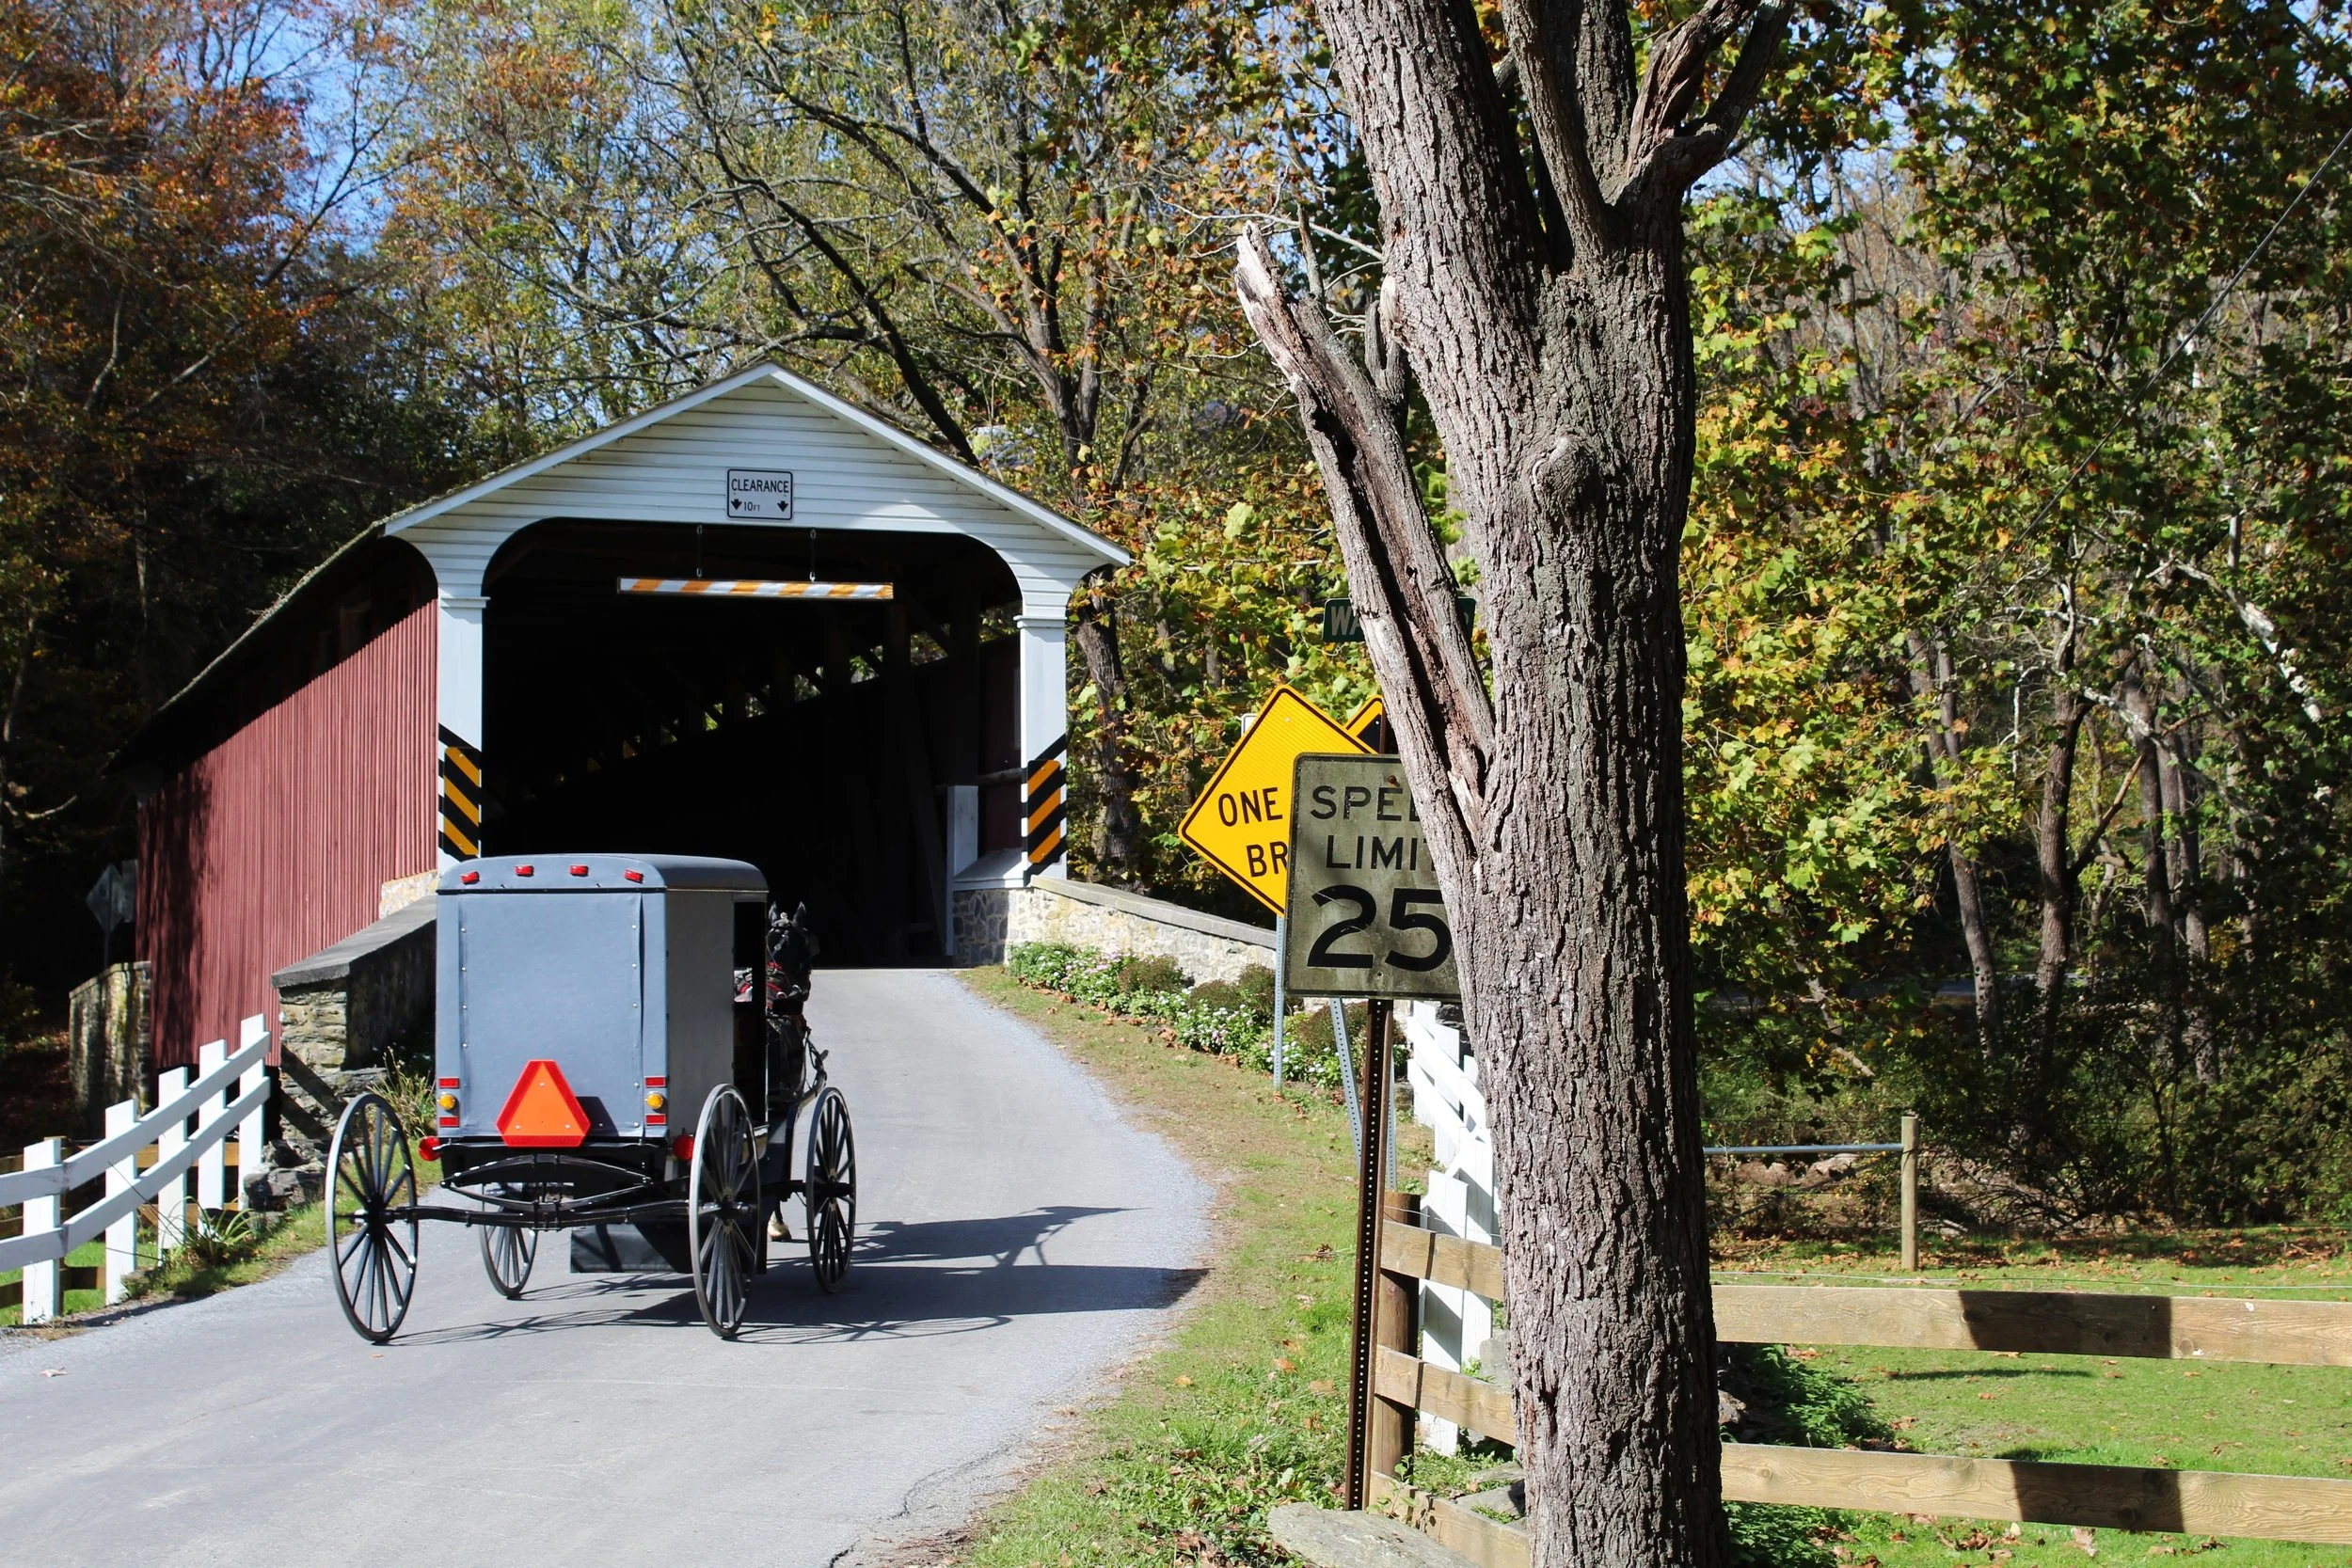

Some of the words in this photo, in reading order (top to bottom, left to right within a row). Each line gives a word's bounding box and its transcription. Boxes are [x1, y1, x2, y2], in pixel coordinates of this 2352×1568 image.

[731, 478, 789, 493] CLEARANCE
[1218, 787, 1283, 827] ONE
[1326, 834, 1436, 871] LIMI
[1307, 884, 1454, 972] 25
